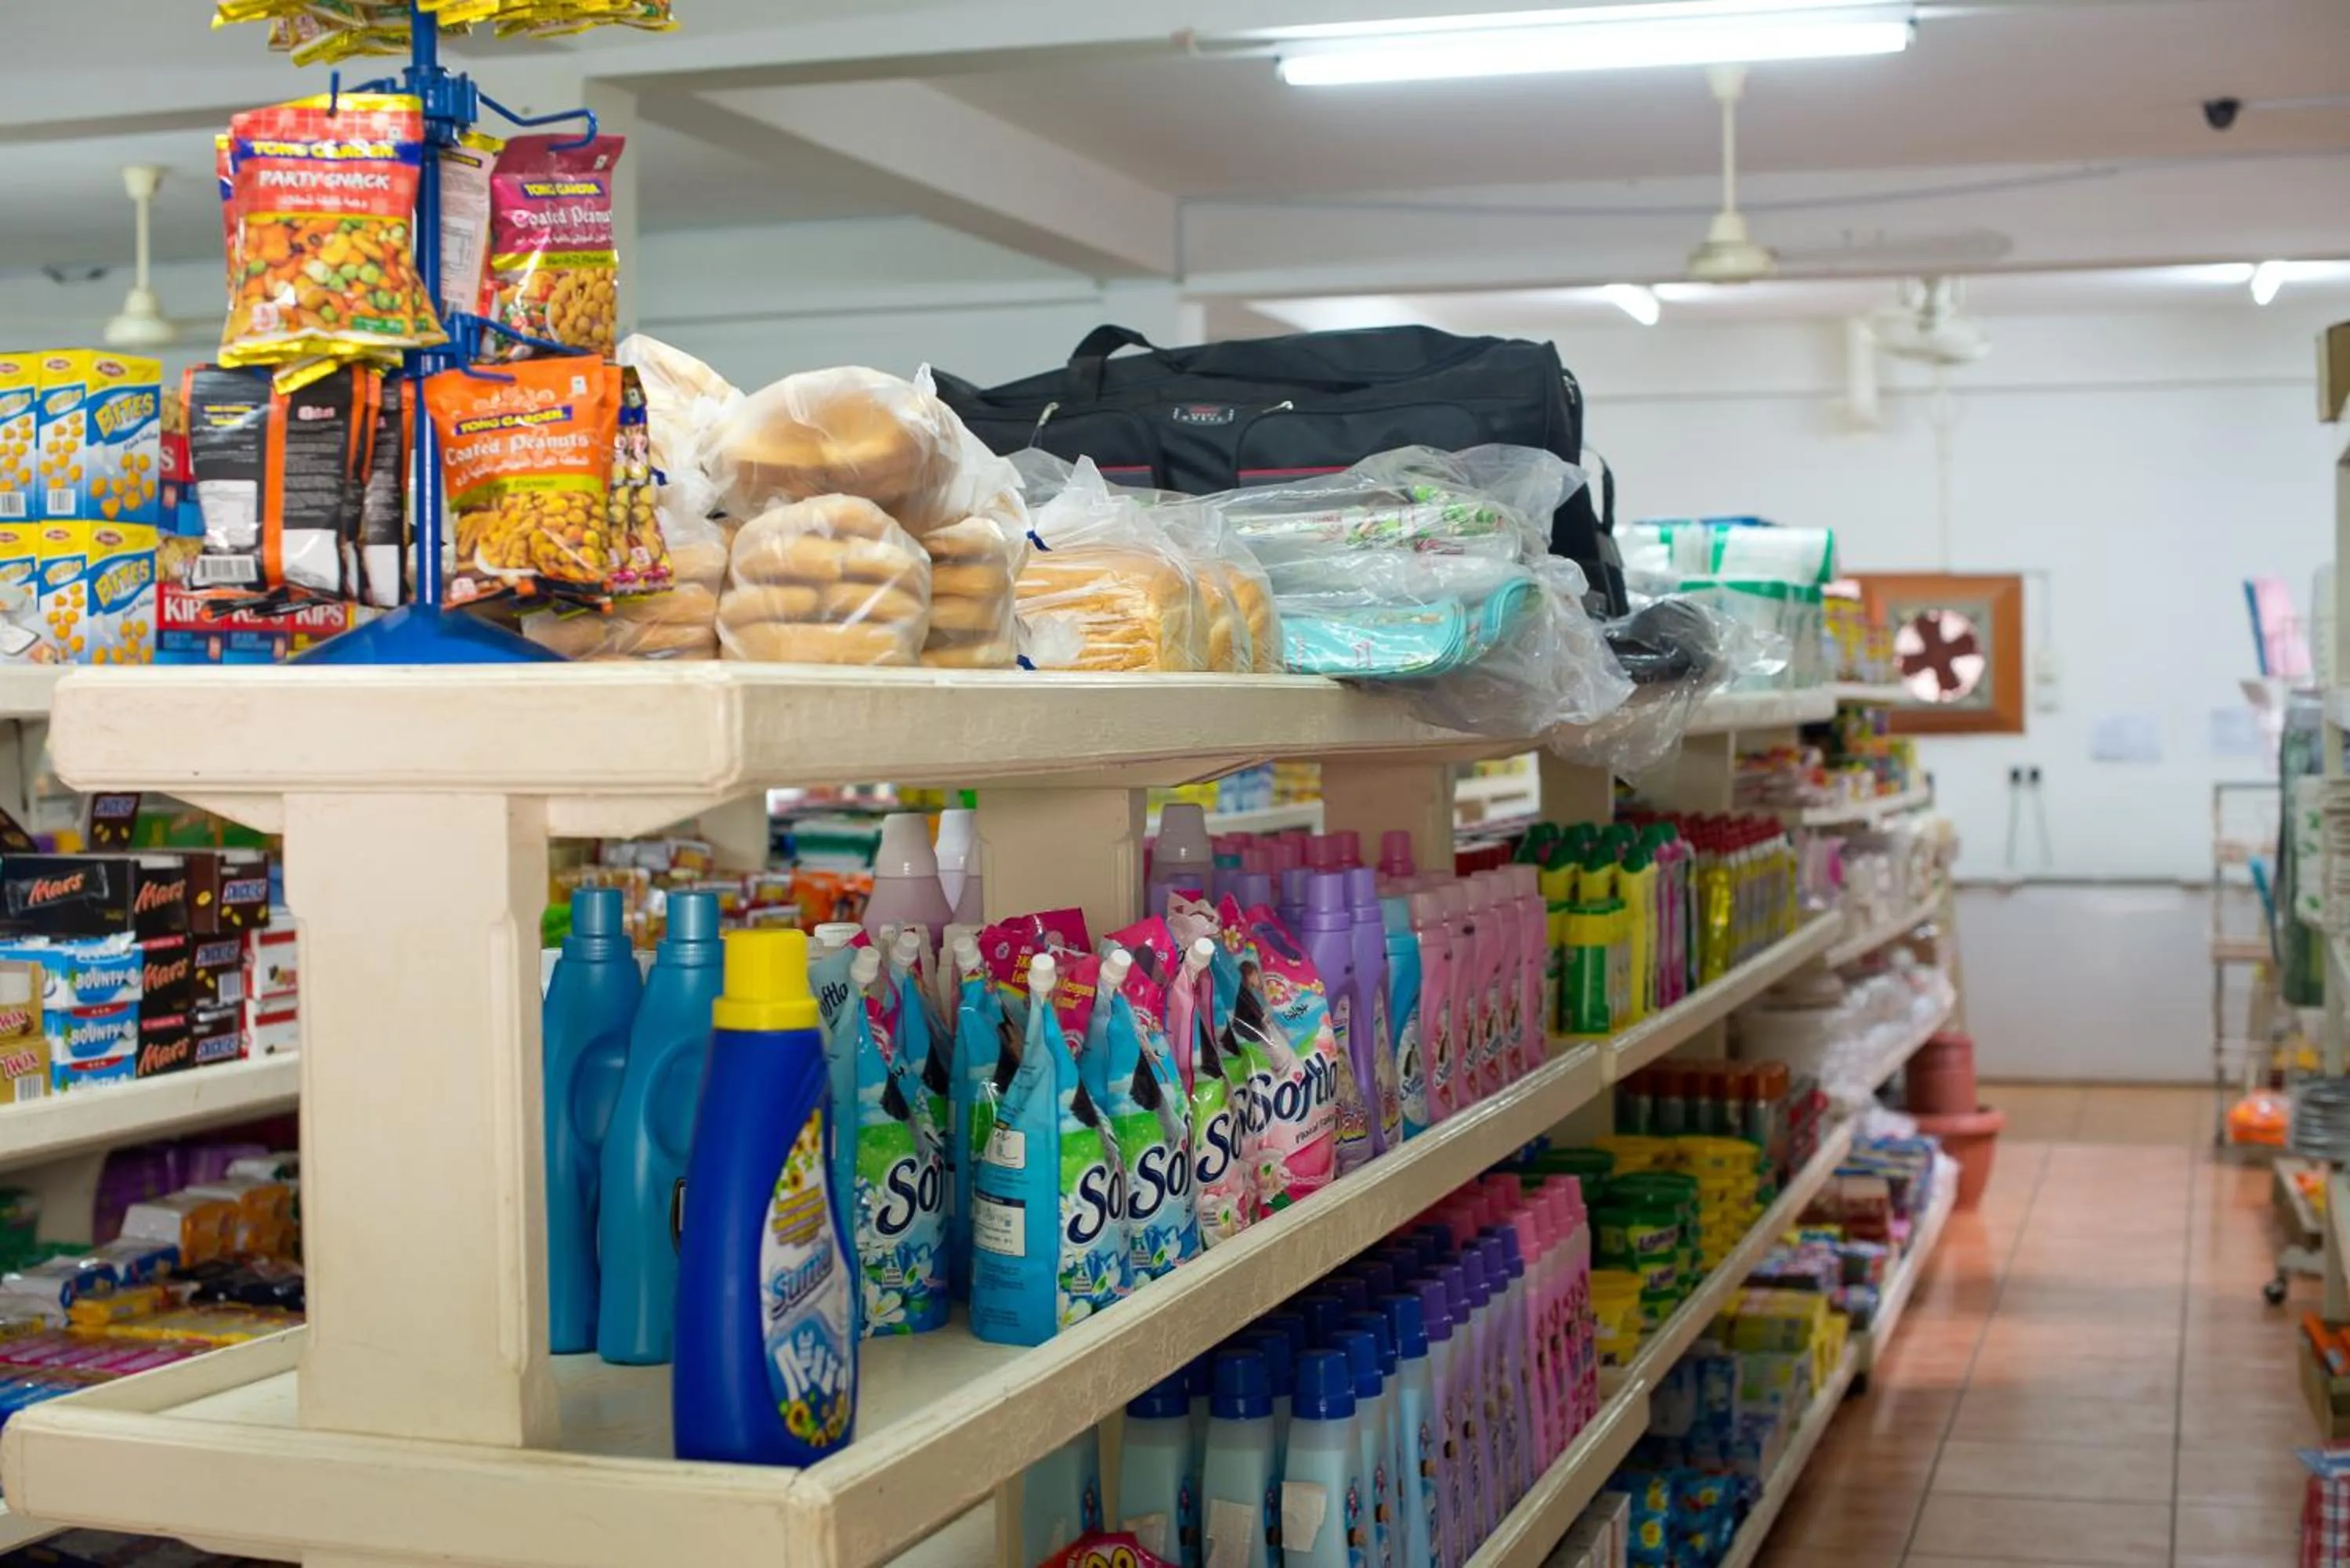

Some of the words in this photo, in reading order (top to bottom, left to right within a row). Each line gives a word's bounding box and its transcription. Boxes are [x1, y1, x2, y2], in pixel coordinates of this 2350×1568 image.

[258, 170, 320, 188] PARTY
[323, 171, 390, 190] SNACK
[512, 208, 566, 228] Coated
[94, 392, 154, 439] BITES
[461, 419, 500, 433] TONG
[501, 409, 564, 427] GARDEN
[445, 439, 501, 466] Coated
[509, 433, 589, 453] Peanuts
[95, 558, 150, 608] BITES
[28, 871, 85, 906] Mars
[134, 879, 186, 914] Mars
[75, 966, 125, 989] BOUNTY
[142, 957, 189, 992] Mars
[70, 1020, 121, 1046] BOUNTY
[138, 1037, 190, 1076] Mars
